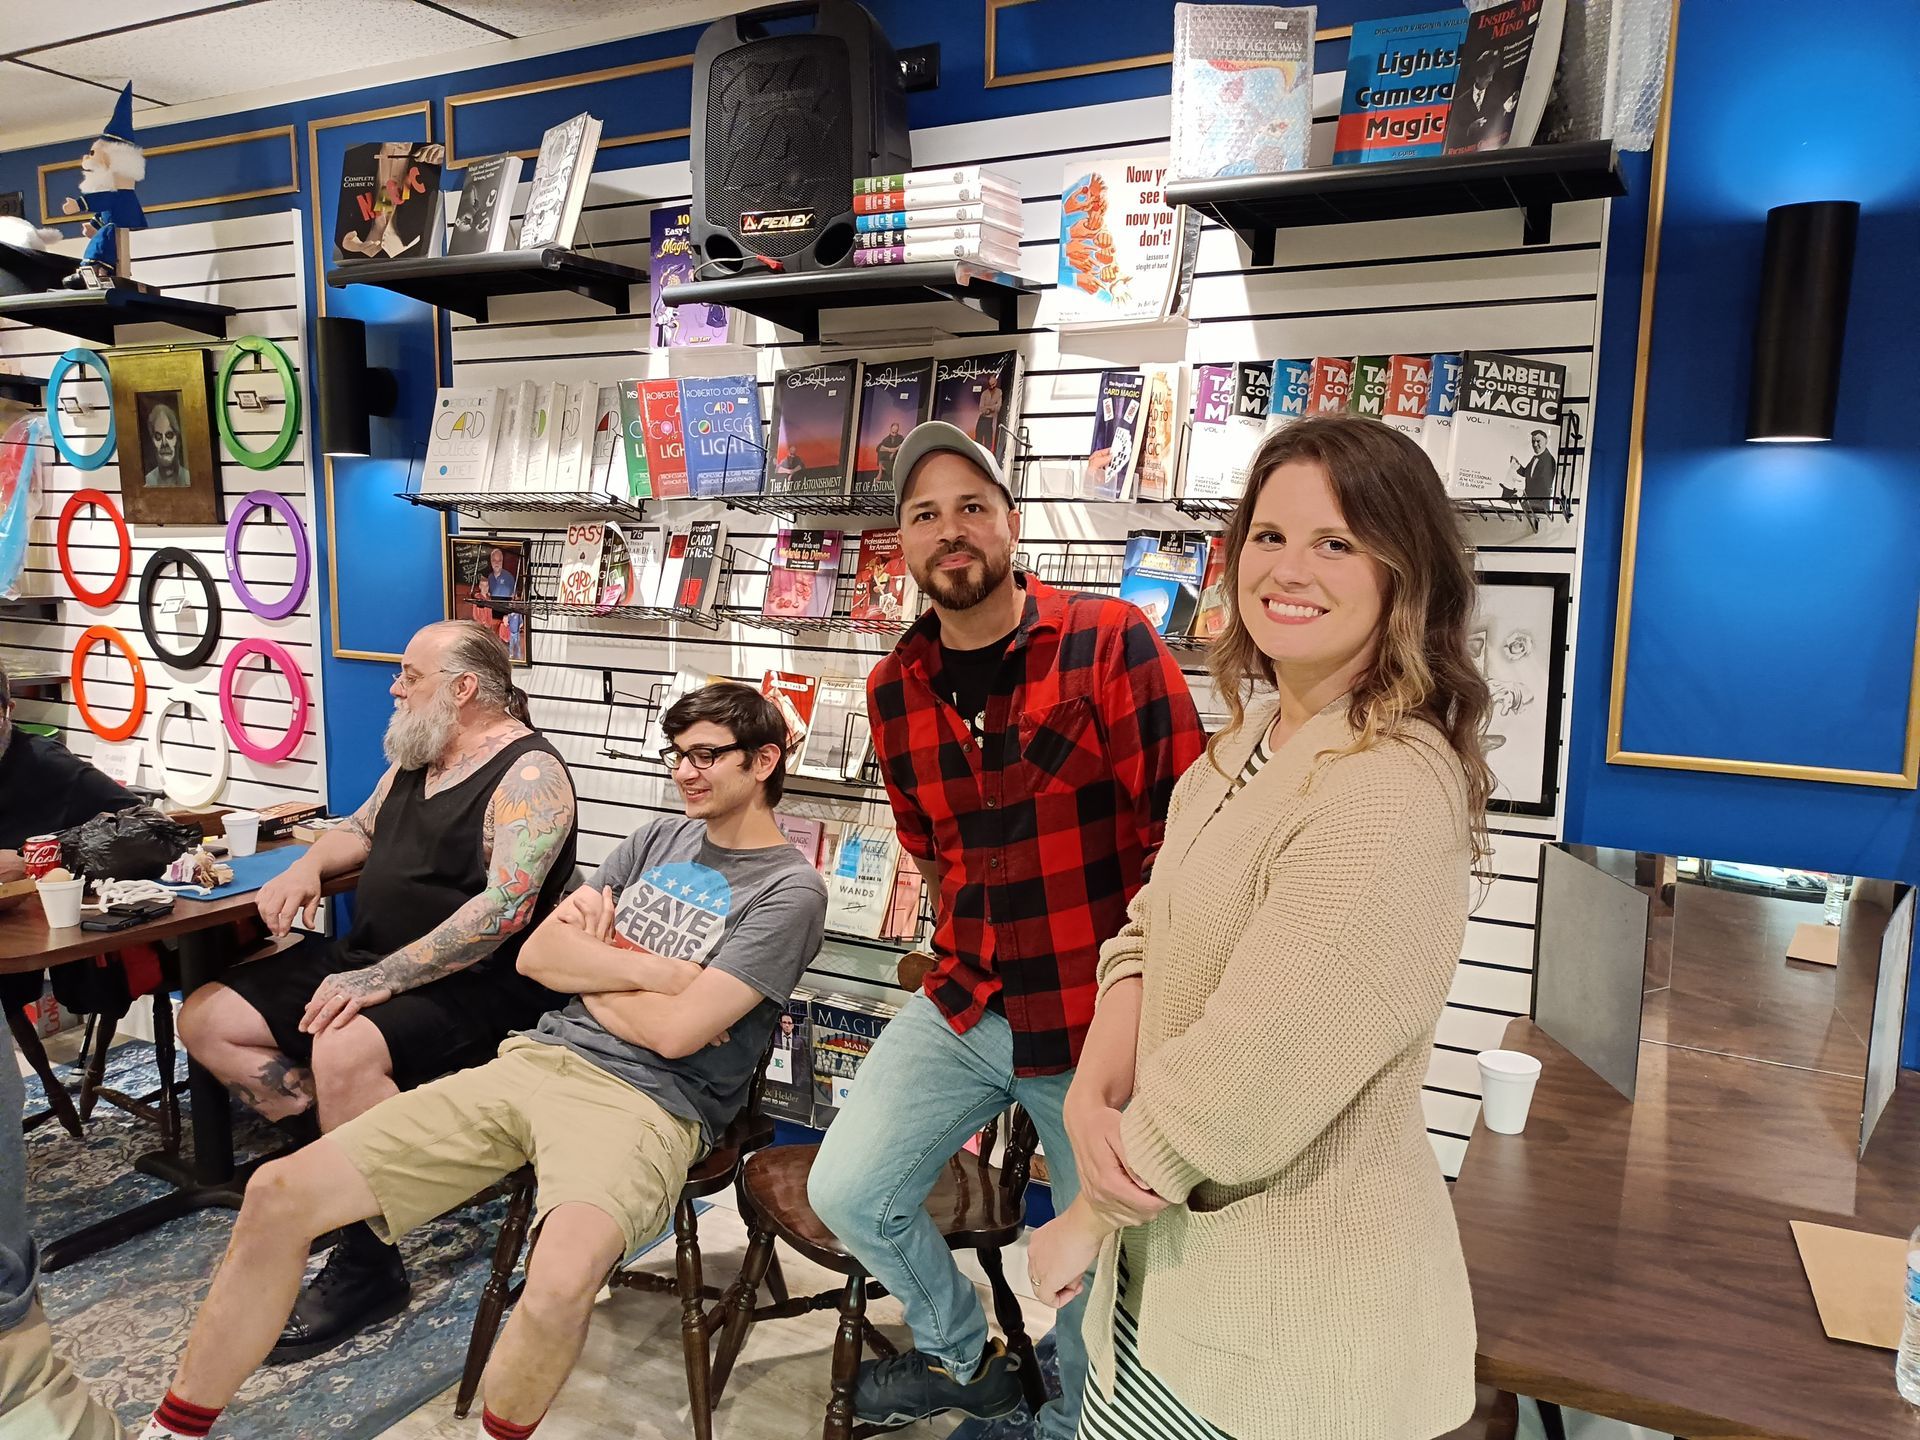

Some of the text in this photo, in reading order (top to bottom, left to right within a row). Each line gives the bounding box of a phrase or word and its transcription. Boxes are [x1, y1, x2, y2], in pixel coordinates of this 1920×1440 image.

[1478, 8, 1517, 29] INSIDE
[1491, 19, 1524, 40] MIND
[1277, 40, 1302, 52] WAY
[1355, 83, 1455, 109] Camera
[1366, 112, 1444, 141] Magic
[1126, 166, 1153, 183] Now
[1140, 190, 1160, 204] see
[757, 213, 814, 229] PEAVEY
[1126, 212, 1173, 230] now you
[1140, 230, 1171, 247] don't!
[814, 366, 846, 391] Harris
[1474, 359, 1561, 389] TARBELL
[687, 388, 721, 398] ROBERTO
[1103, 388, 1140, 398] CARD MAGIC
[1476, 379, 1557, 400] COURSE IN
[704, 401, 735, 416] CARD
[1469, 389, 1558, 421] MAGIC
[436, 410, 485, 440] CARD
[689, 417, 751, 438] COLLEGE
[1466, 416, 1486, 425] VOL.
[701, 438, 746, 456] LIGHT
[771, 479, 782, 493] THE
[782, 478, 793, 492] ART
[793, 480, 801, 491] OF
[801, 476, 842, 490] ASTONISHMENT
[863, 481, 871, 492] OF
[569, 525, 603, 545] EASY
[632, 530, 643, 539] 75
[690, 534, 713, 546] CARD
[803, 532, 812, 543] 25
[864, 537, 890, 545] Professional
[685, 546, 714, 559] TRICKS
[801, 549, 809, 560] to
[810, 549, 830, 560] Dimes
[568, 570, 591, 590] CARD
[827, 681, 846, 689] Super
[790, 836, 808, 845] MAGIC
[839, 885, 875, 898] WANDS
[633, 884, 718, 940] SAVE
[615, 906, 702, 962] FERRIS
[844, 1040, 868, 1052] MAIN
[774, 1058, 784, 1069] E
[774, 1090, 799, 1102] Helder
